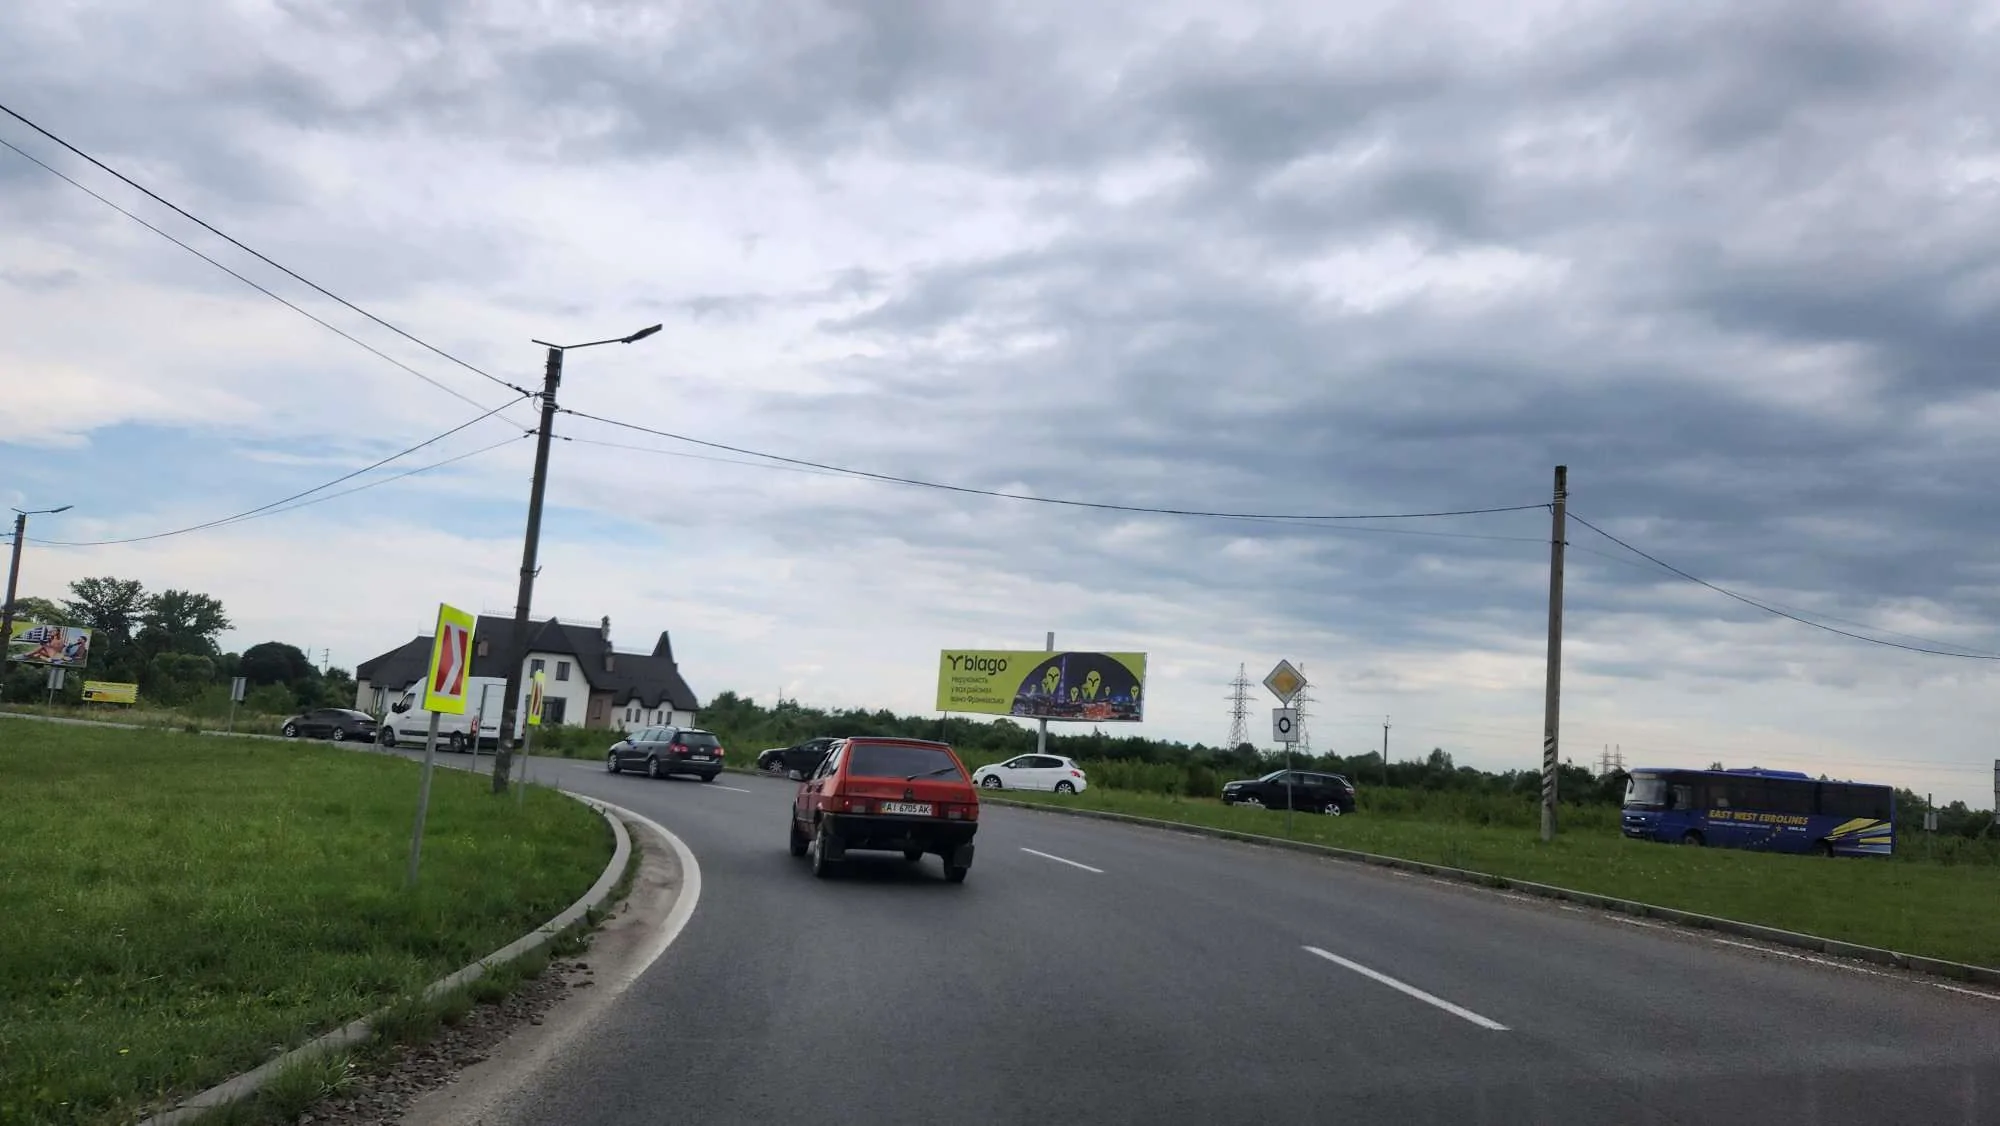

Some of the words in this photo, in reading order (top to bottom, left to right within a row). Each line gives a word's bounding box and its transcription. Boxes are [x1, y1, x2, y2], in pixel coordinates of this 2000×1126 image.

[965, 655, 1007, 675] blago
[900, 804, 917, 813] 6705
[918, 805, 929, 814] AK
[1708, 809, 1732, 819] EAST
[1733, 811, 1758, 821] WEST
[1759, 813, 1809, 825] EUROLINES
